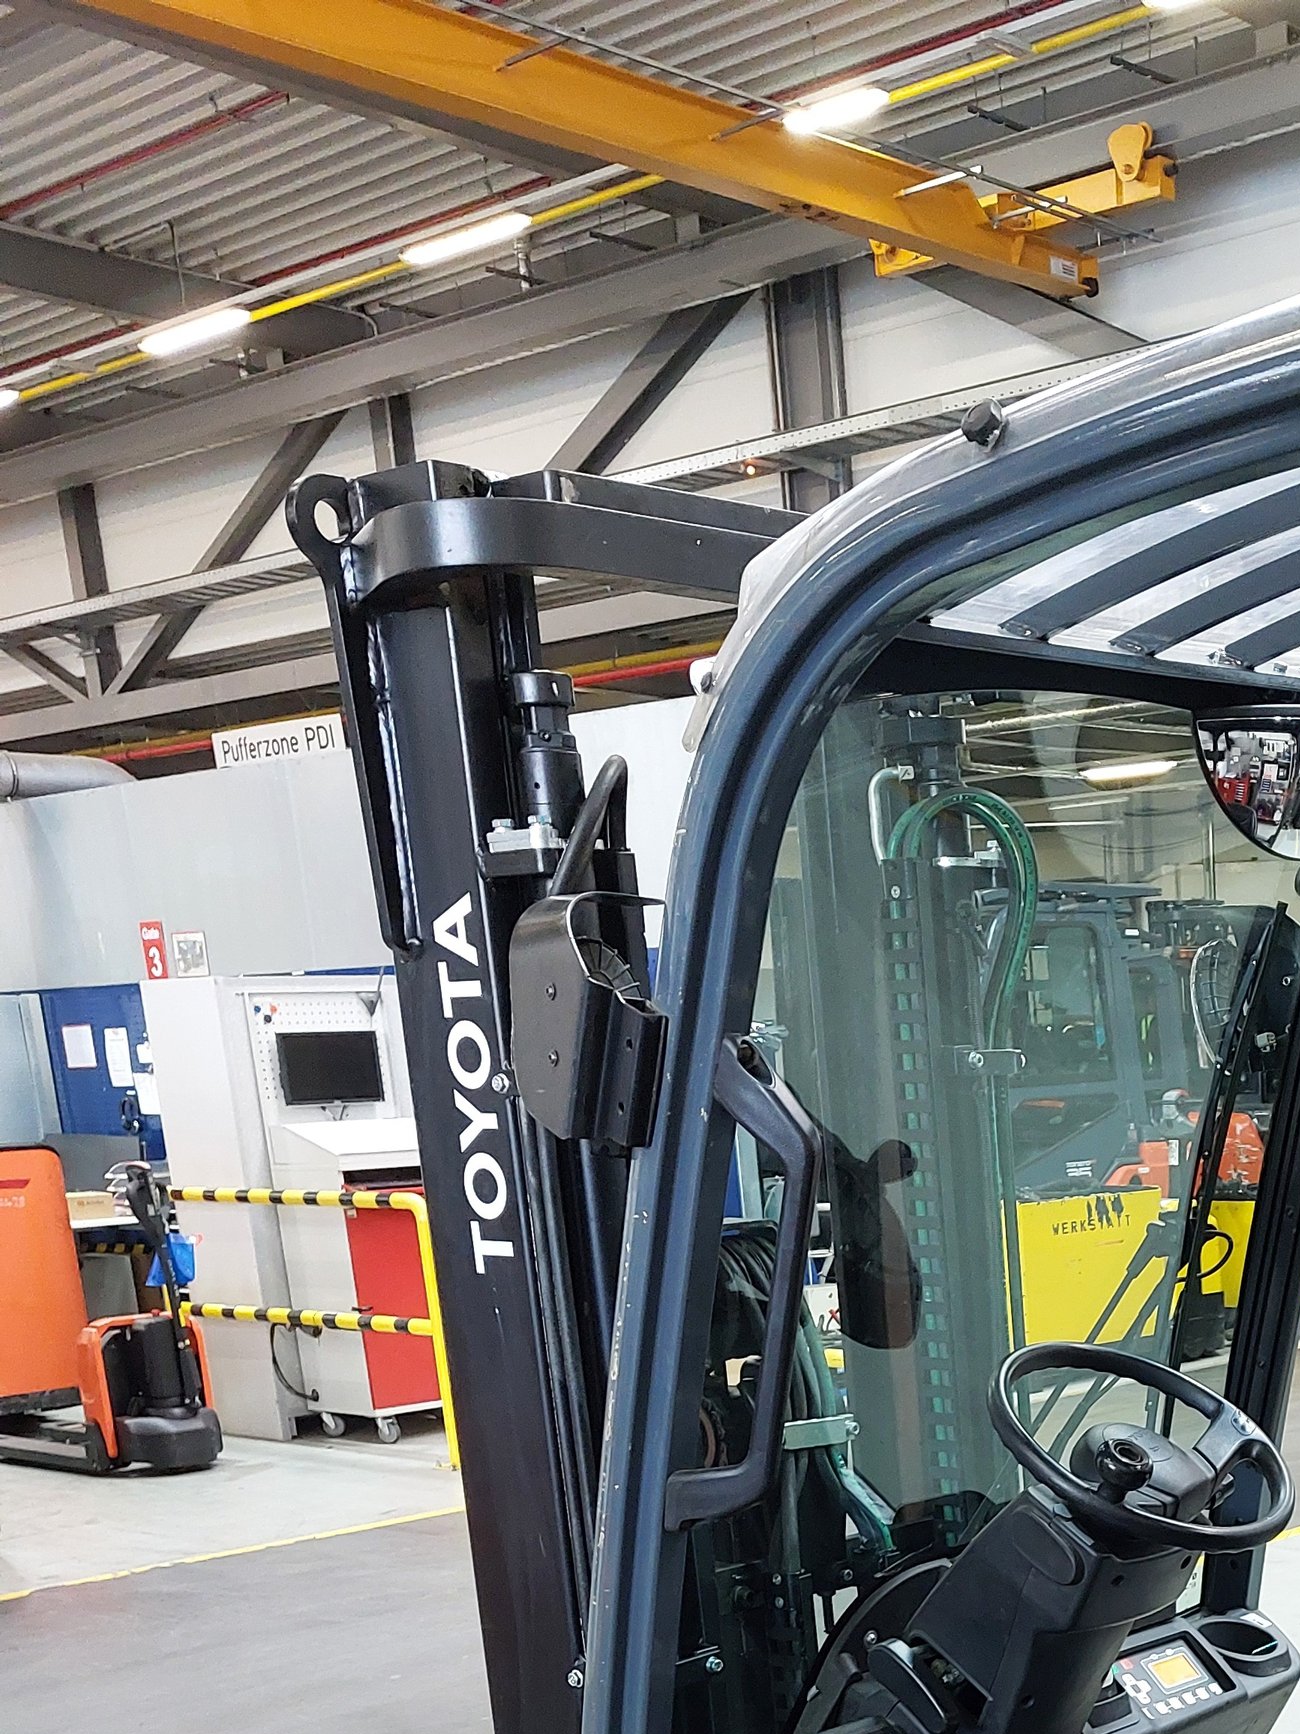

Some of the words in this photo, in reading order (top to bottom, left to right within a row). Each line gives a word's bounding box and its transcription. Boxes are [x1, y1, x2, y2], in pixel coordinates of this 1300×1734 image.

[221, 735, 299, 763] Pufferzone
[304, 723, 336, 752] PDI
[147, 945, 164, 978] 3
[432, 891, 516, 1275] TOYOTA
[1052, 1214, 1132, 1235] WERKSTATT
